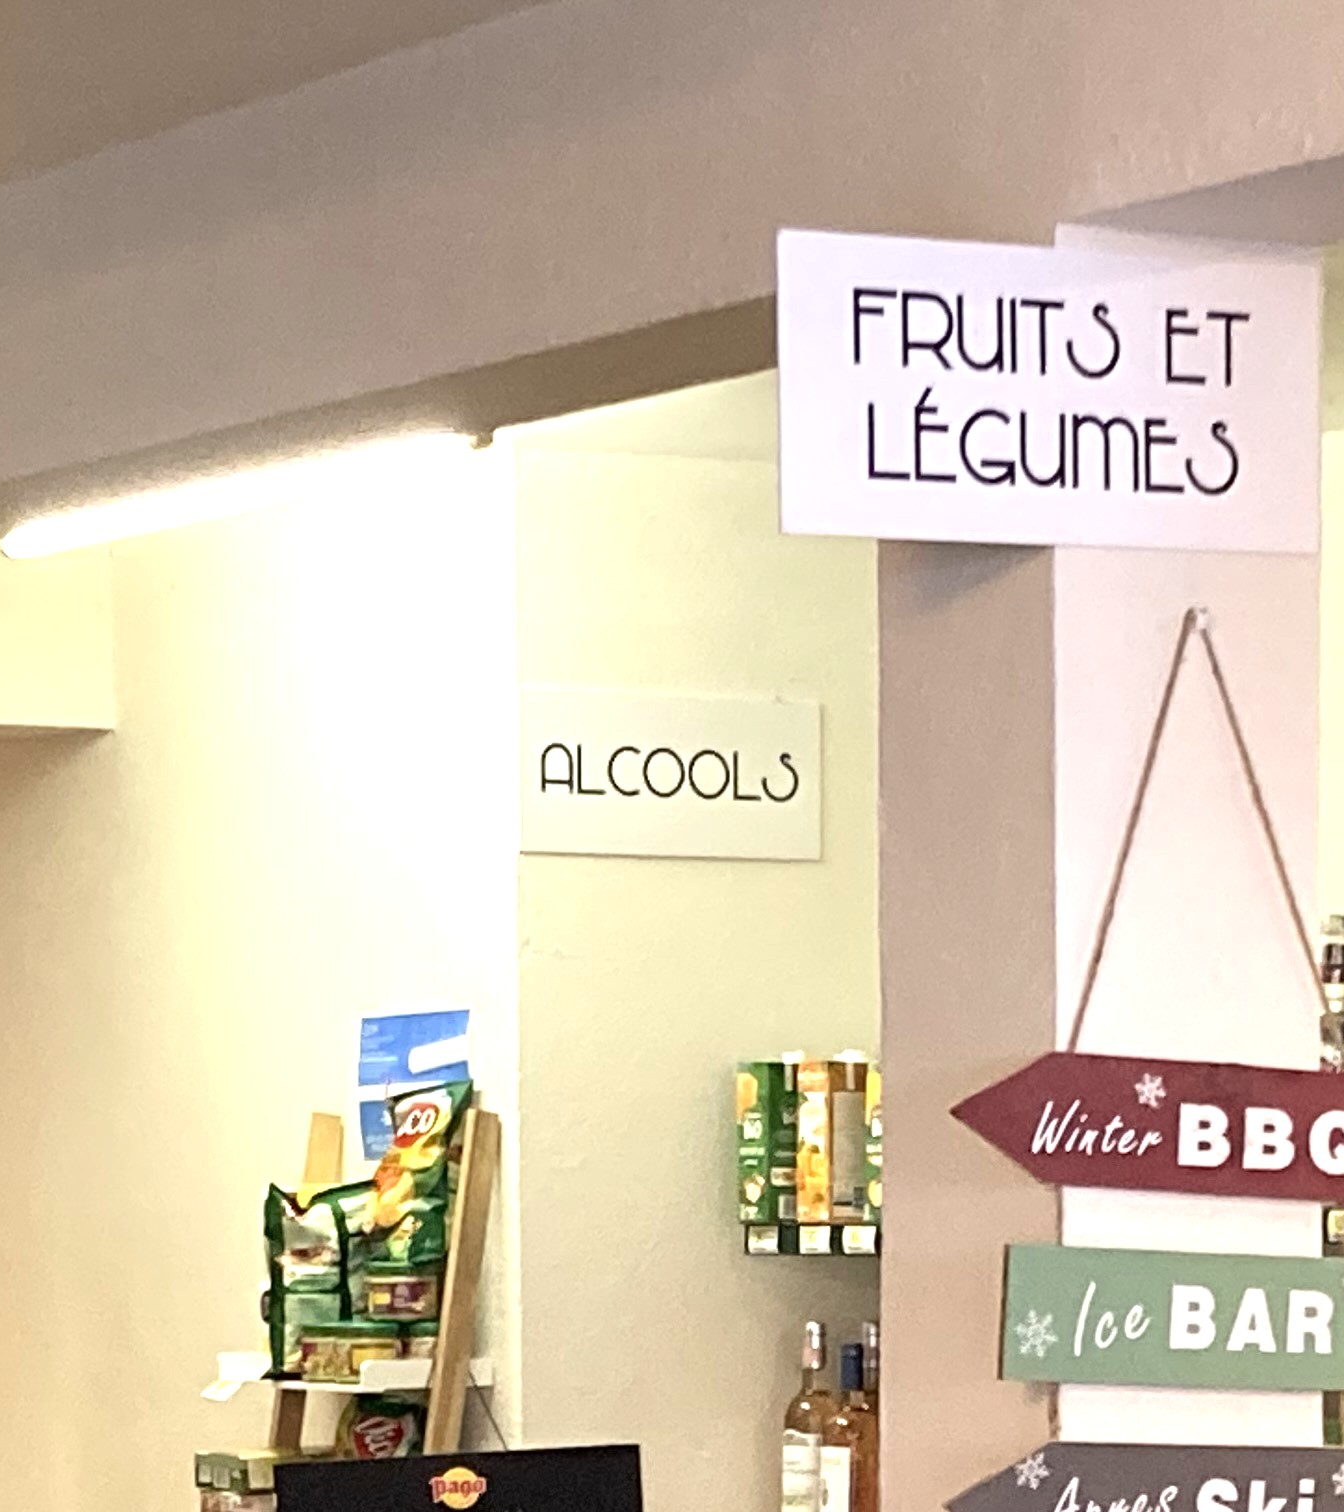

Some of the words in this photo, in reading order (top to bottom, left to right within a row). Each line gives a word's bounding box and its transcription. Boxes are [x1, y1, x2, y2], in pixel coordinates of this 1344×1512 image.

[853, 287, 1121, 379] FRUITS
[1165, 308, 1251, 387] ET
[867, 386, 1240, 496] LÉGUMES
[540, 742, 799, 803] ALCOOLS
[1030, 1099, 1163, 1157] Winter
[1073, 1280, 1151, 1357] Ice
[1168, 1284, 1335, 1355] BAR
[430, 1477, 487, 1502] pago
